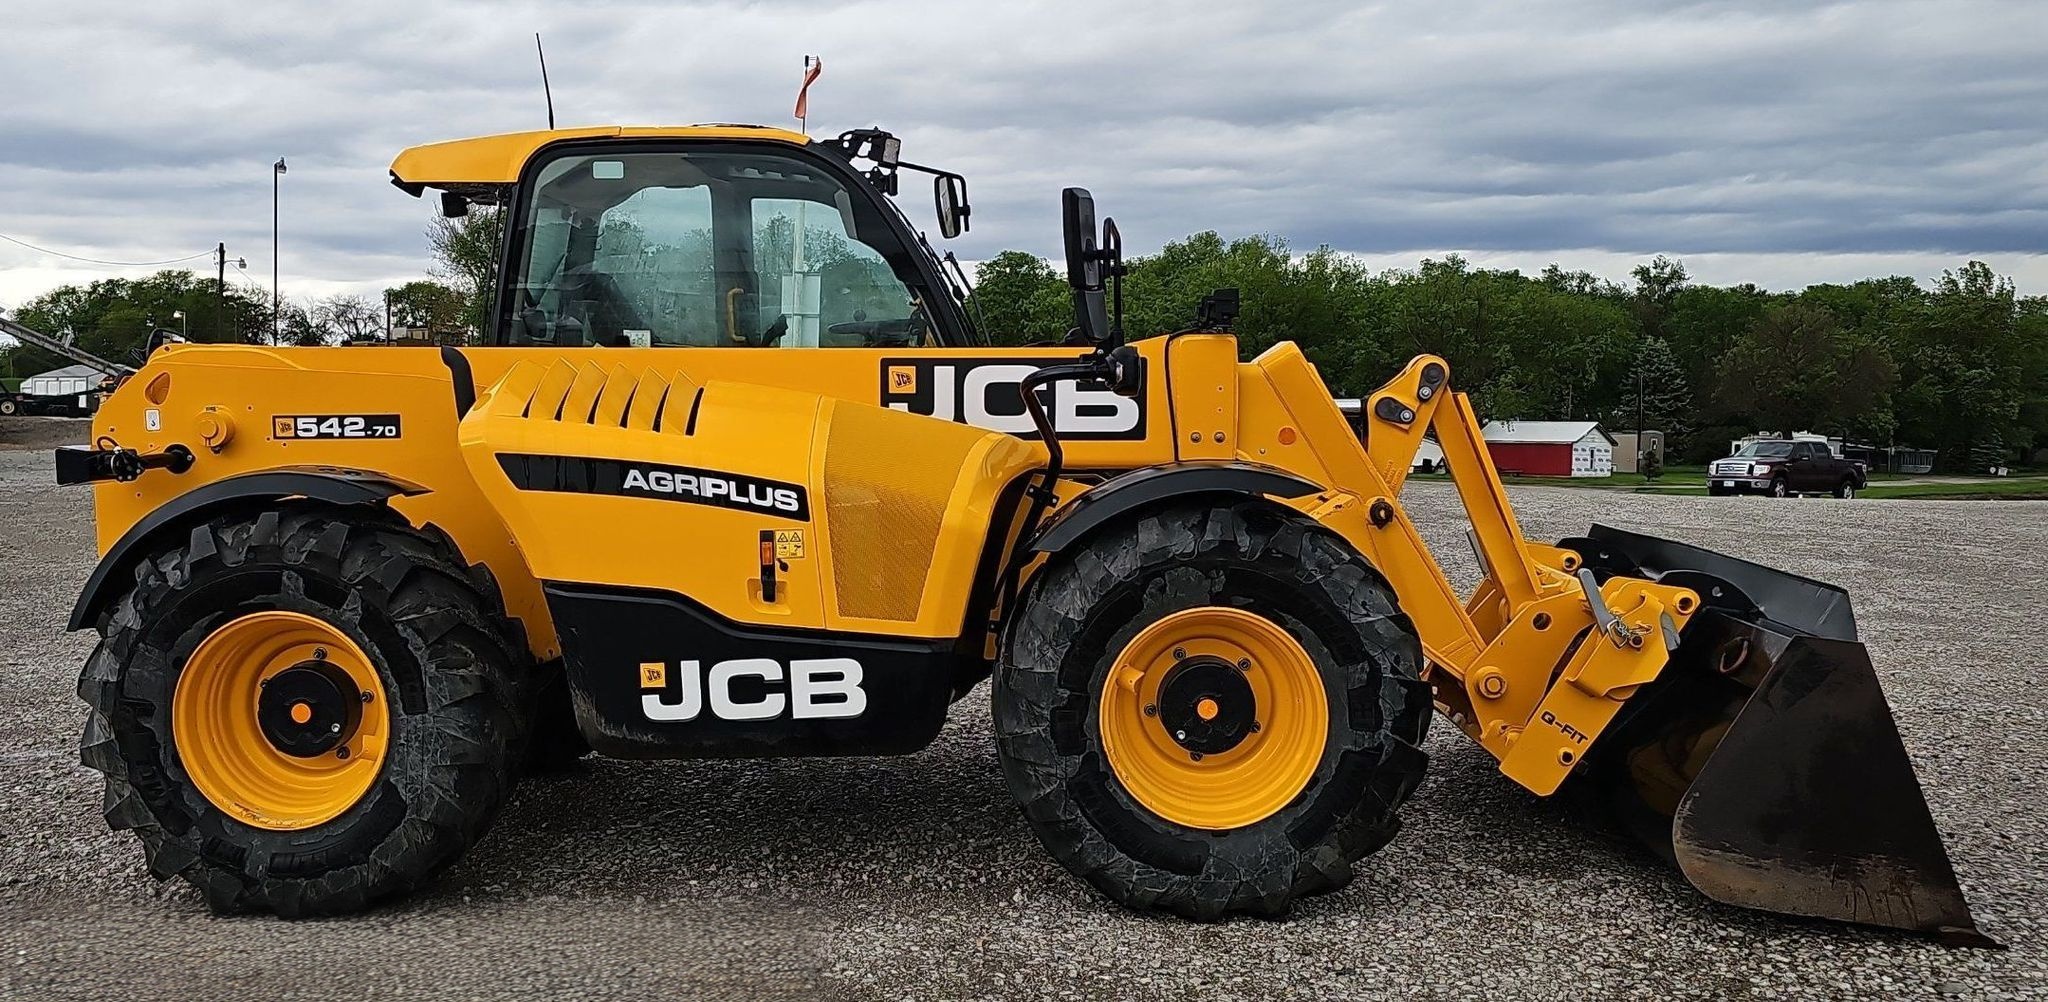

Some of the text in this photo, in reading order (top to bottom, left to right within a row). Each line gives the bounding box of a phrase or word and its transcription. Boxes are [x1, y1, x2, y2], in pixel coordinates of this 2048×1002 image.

[888, 364, 1140, 432] JCB
[623, 468, 799, 511] AGRIPLUS
[641, 658, 867, 721] JCB
[1540, 710, 1589, 744] Q-FIT
